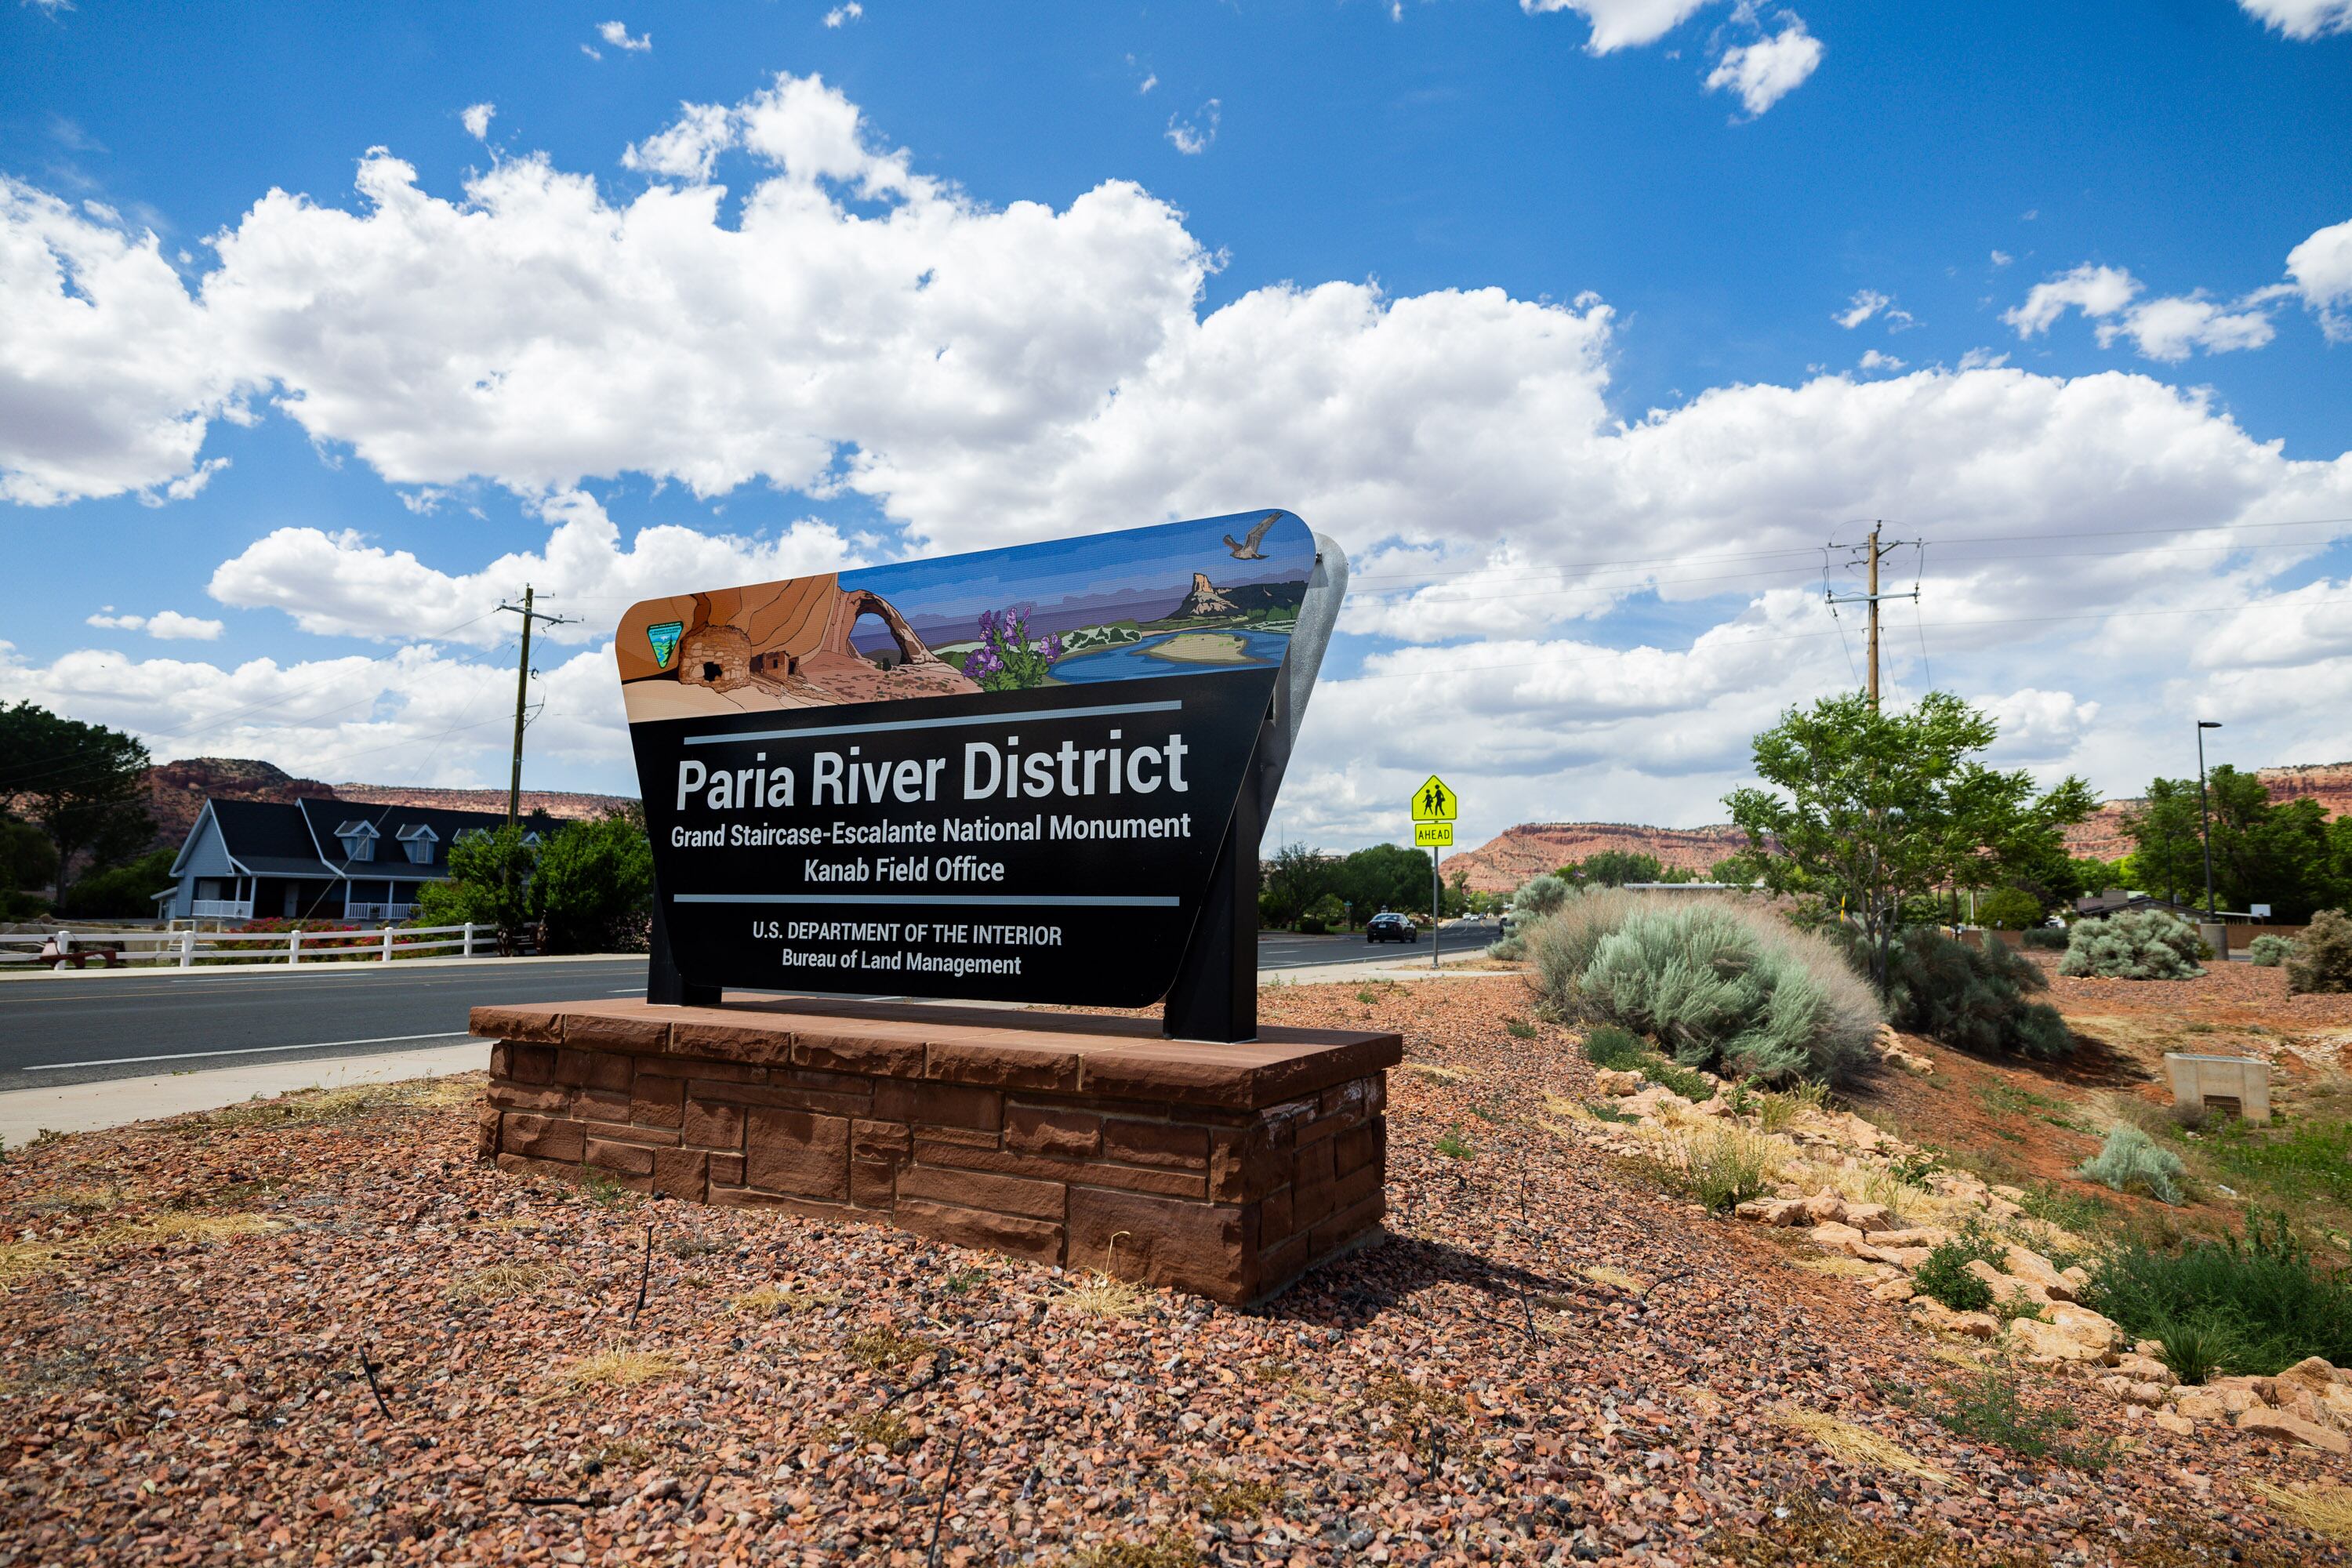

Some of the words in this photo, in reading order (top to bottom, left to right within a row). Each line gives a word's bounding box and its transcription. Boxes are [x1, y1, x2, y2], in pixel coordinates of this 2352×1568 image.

[677, 752, 794, 811] Paria
[811, 746, 946, 806] River
[964, 728, 1189, 800] District
[671, 823, 726, 848] Grand
[730, 818, 936, 846] Staircase-Escalante
[942, 814, 1042, 842] National
[1050, 813, 1191, 840] Monument
[1419, 829, 1450, 840] AHEAD
[804, 857, 869, 882] Kanab
[876, 856, 929, 882] Field
[935, 855, 1004, 881] Office
[753, 920, 783, 939] U.S.
[788, 921, 901, 942] DEPARTMENT
[905, 924, 928, 942] OF
[932, 924, 968, 943] THE
[973, 924, 1062, 946] INTERIOR
[782, 948, 837, 967] Bureau
[840, 949, 858, 968] of
[861, 950, 902, 970] Land
[906, 952, 1022, 978] Management
